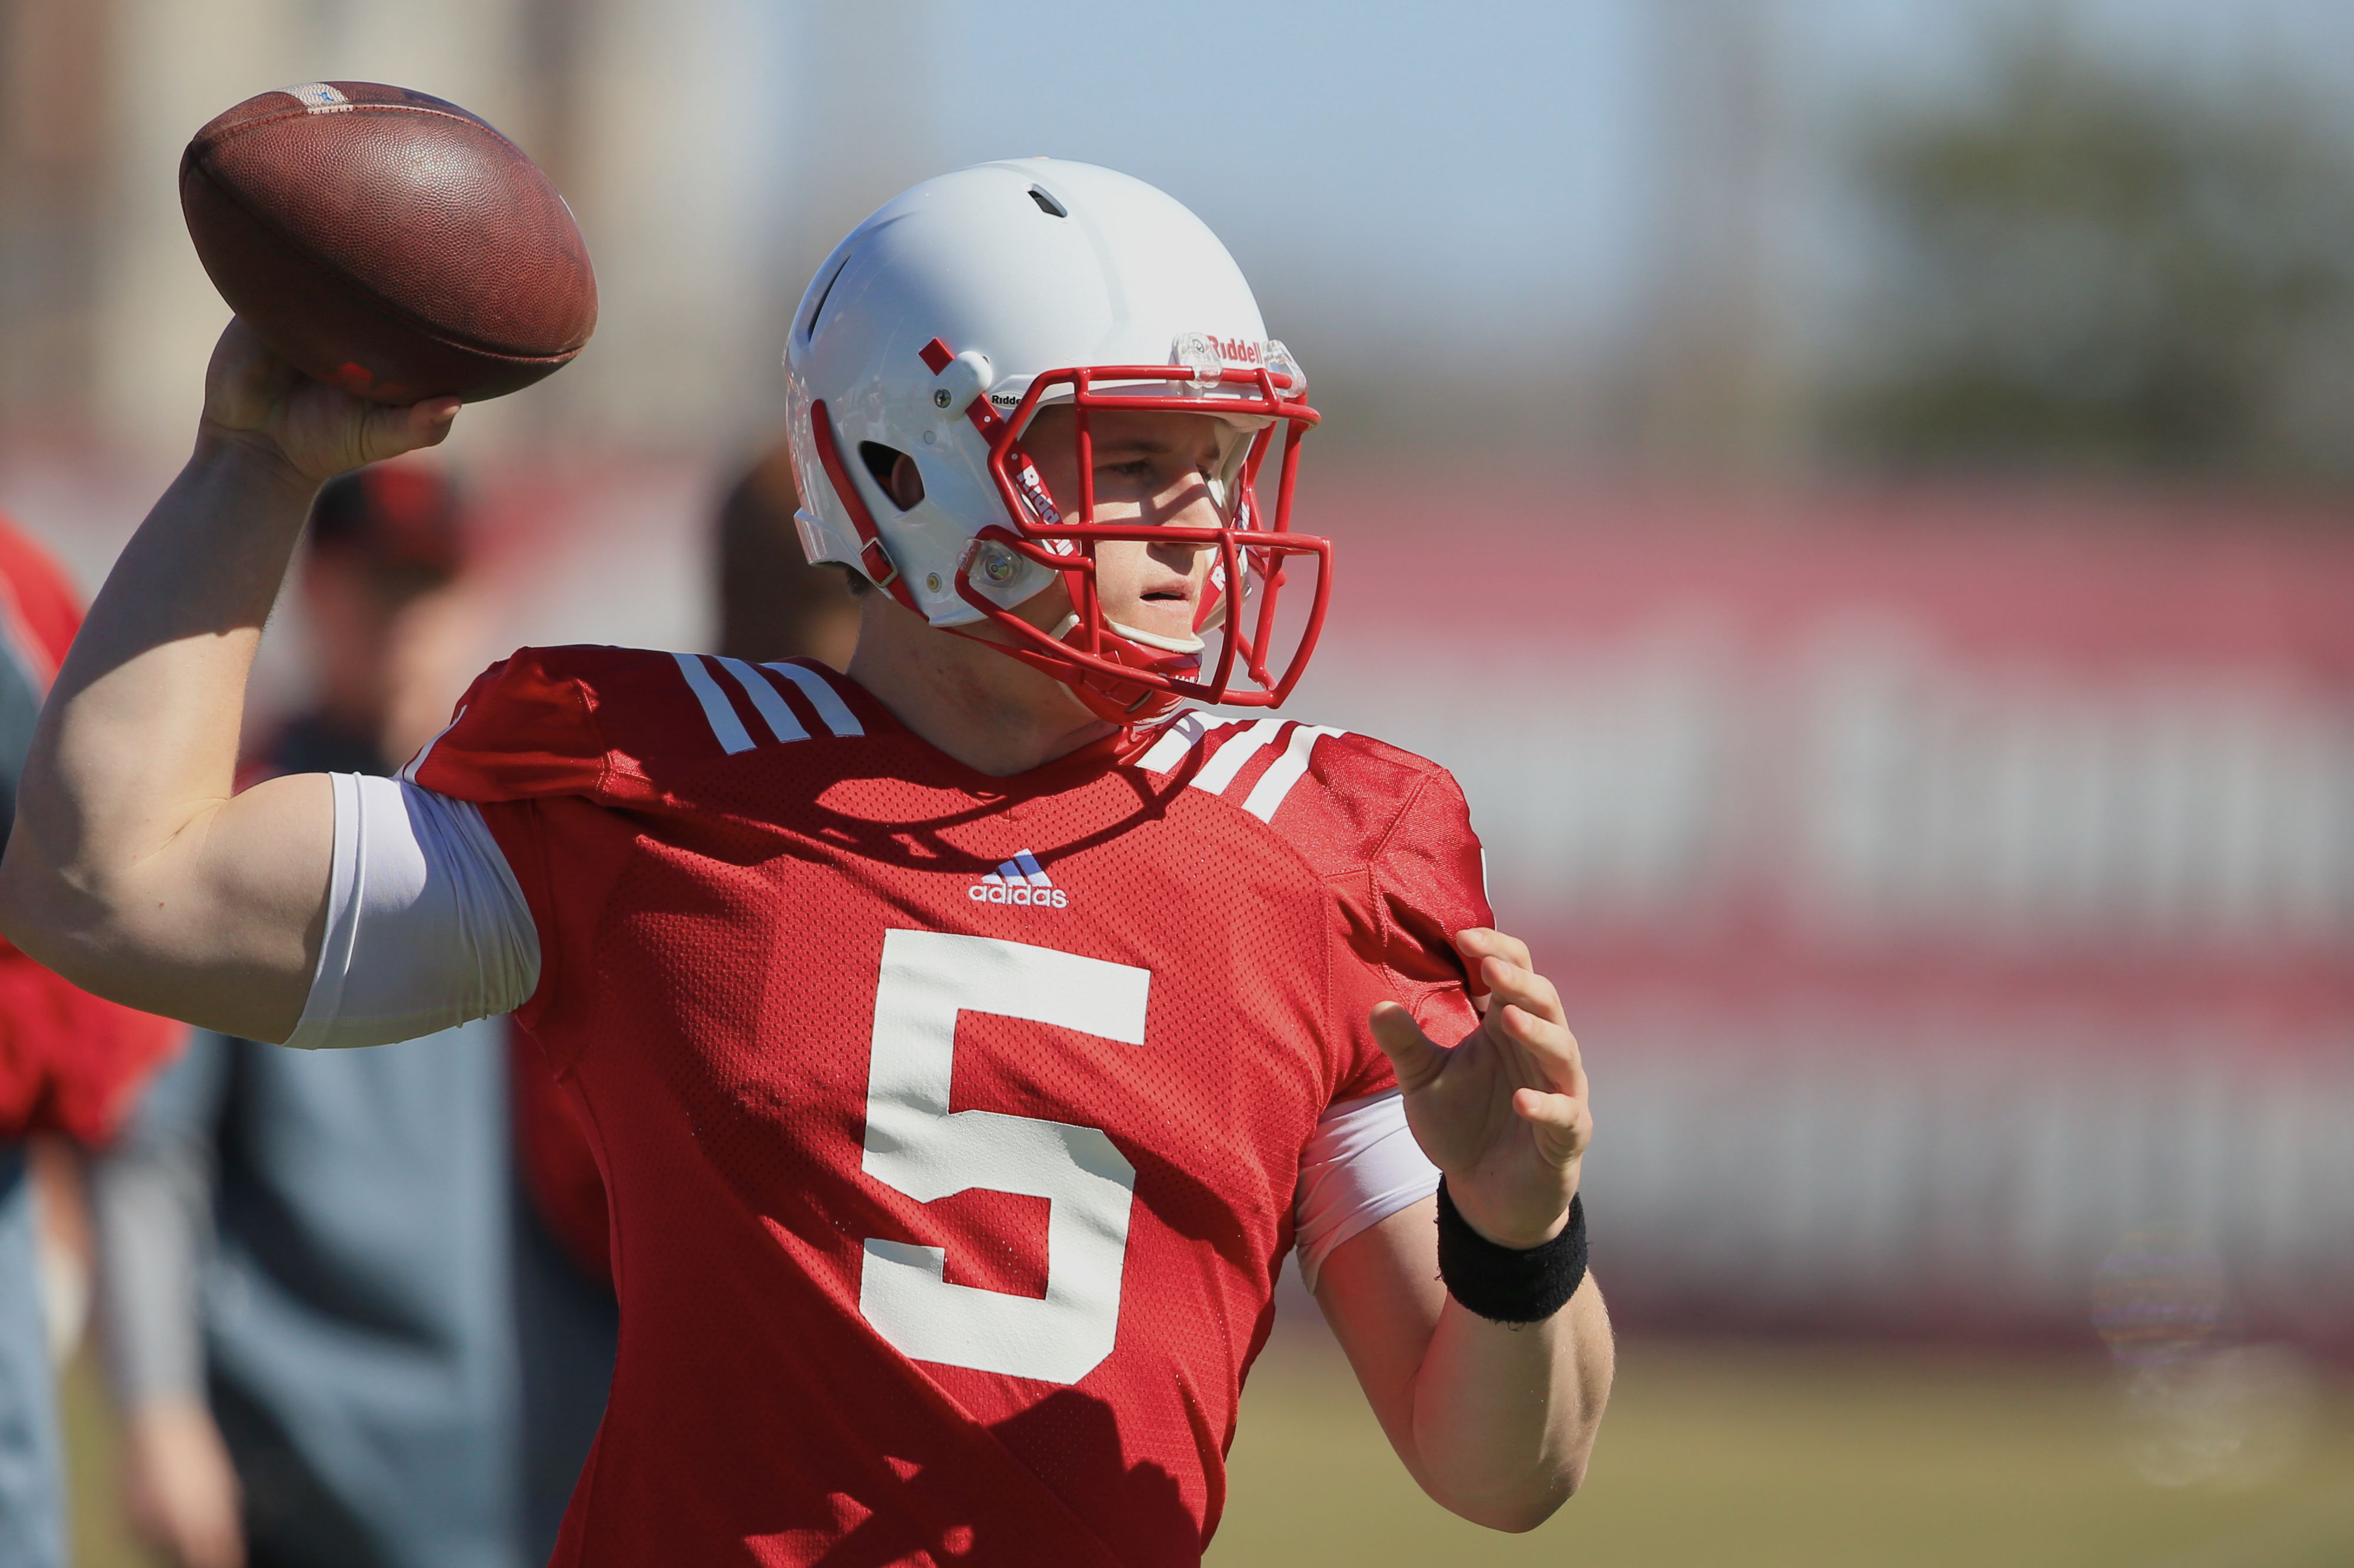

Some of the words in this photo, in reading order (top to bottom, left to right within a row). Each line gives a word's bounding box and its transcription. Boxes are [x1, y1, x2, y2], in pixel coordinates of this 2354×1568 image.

[1206, 334, 1262, 364] Riddell
[992, 395, 1022, 405] Ridde
[1016, 465, 1074, 557] Riddll
[968, 883, 1068, 908] adidas
[859, 928, 1151, 1386] 5
